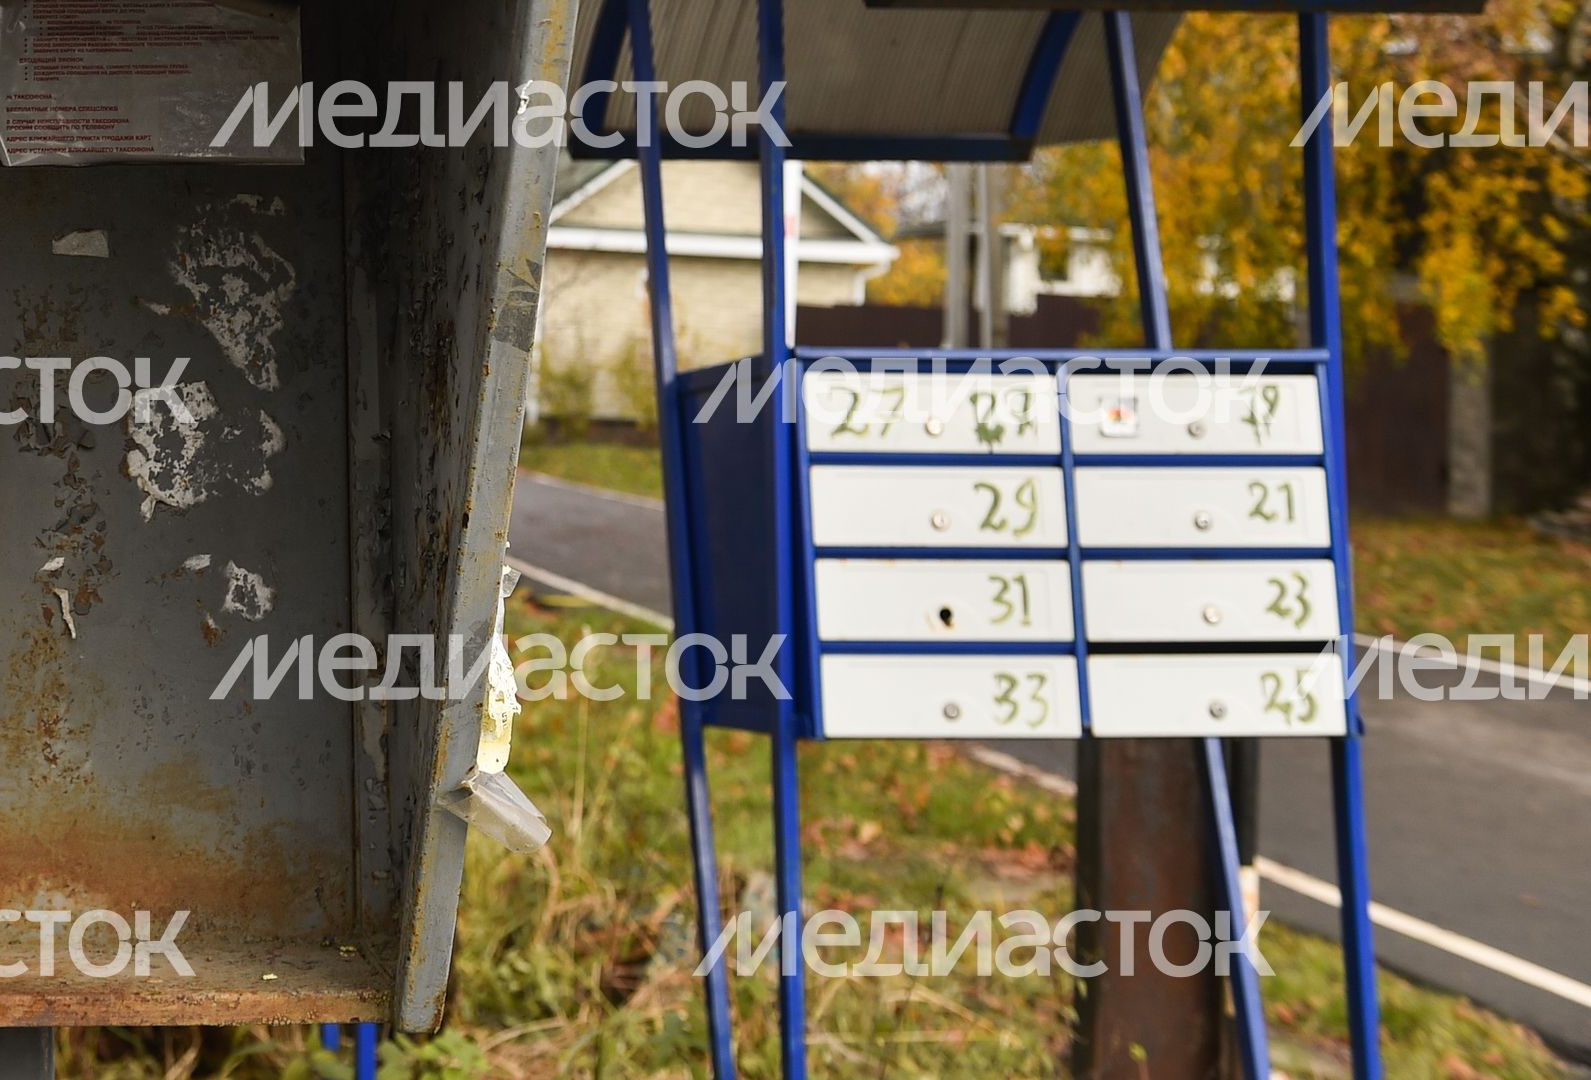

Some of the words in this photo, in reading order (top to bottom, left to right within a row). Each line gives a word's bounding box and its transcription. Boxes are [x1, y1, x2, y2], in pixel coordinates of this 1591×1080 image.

[974, 478, 1038, 537] 29
[1249, 481, 1296, 522] 21
[988, 575, 1033, 628] 31
[1265, 571, 1313, 628] 23
[993, 673, 1050, 728] 33
